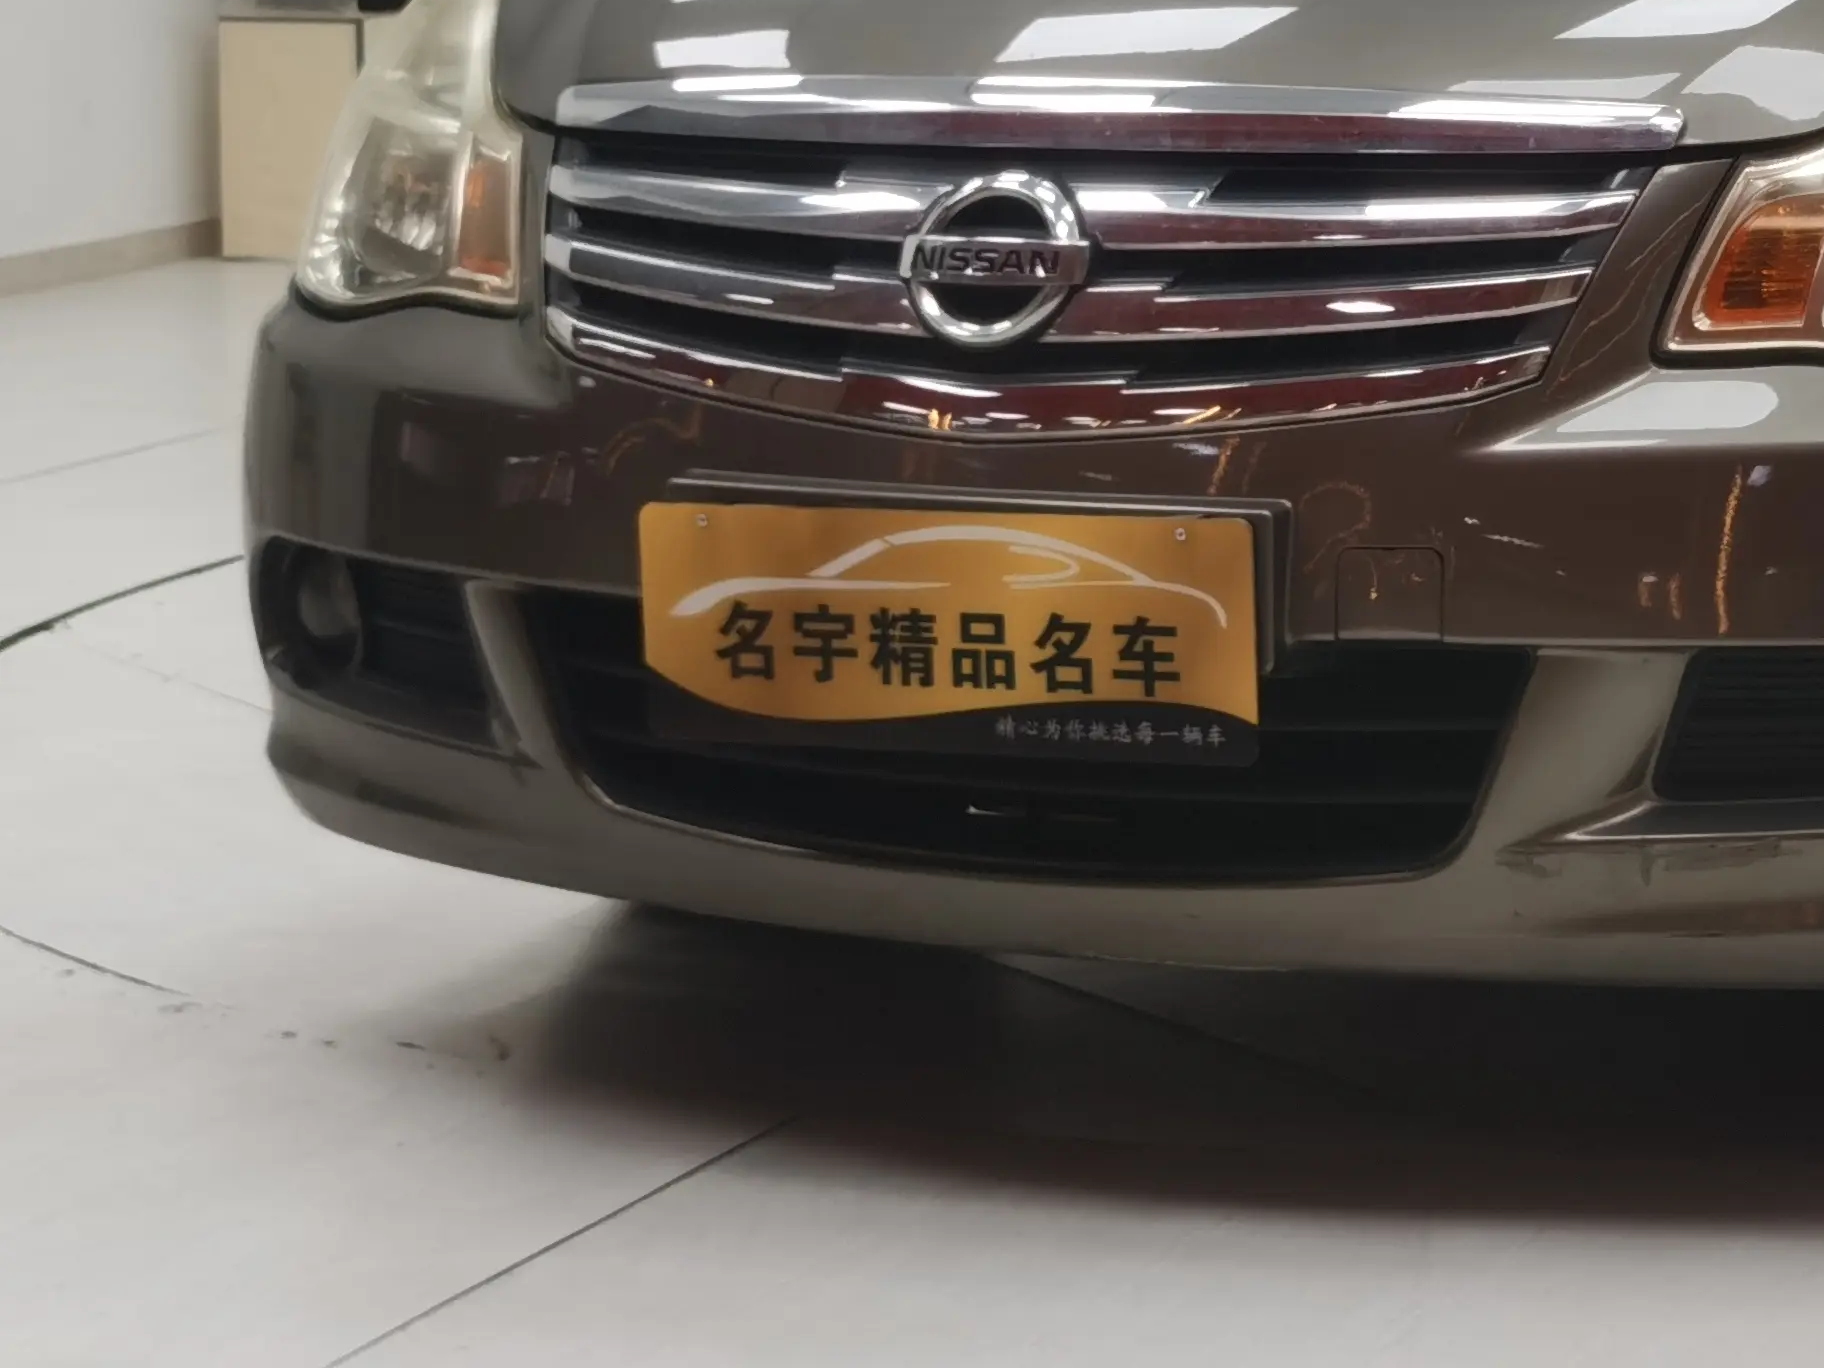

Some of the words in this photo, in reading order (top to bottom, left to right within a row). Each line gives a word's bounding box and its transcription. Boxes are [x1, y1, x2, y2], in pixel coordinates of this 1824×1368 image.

[913, 243, 1060, 276] NISSAN
[715, 601, 1181, 697] 名宇精品名车
